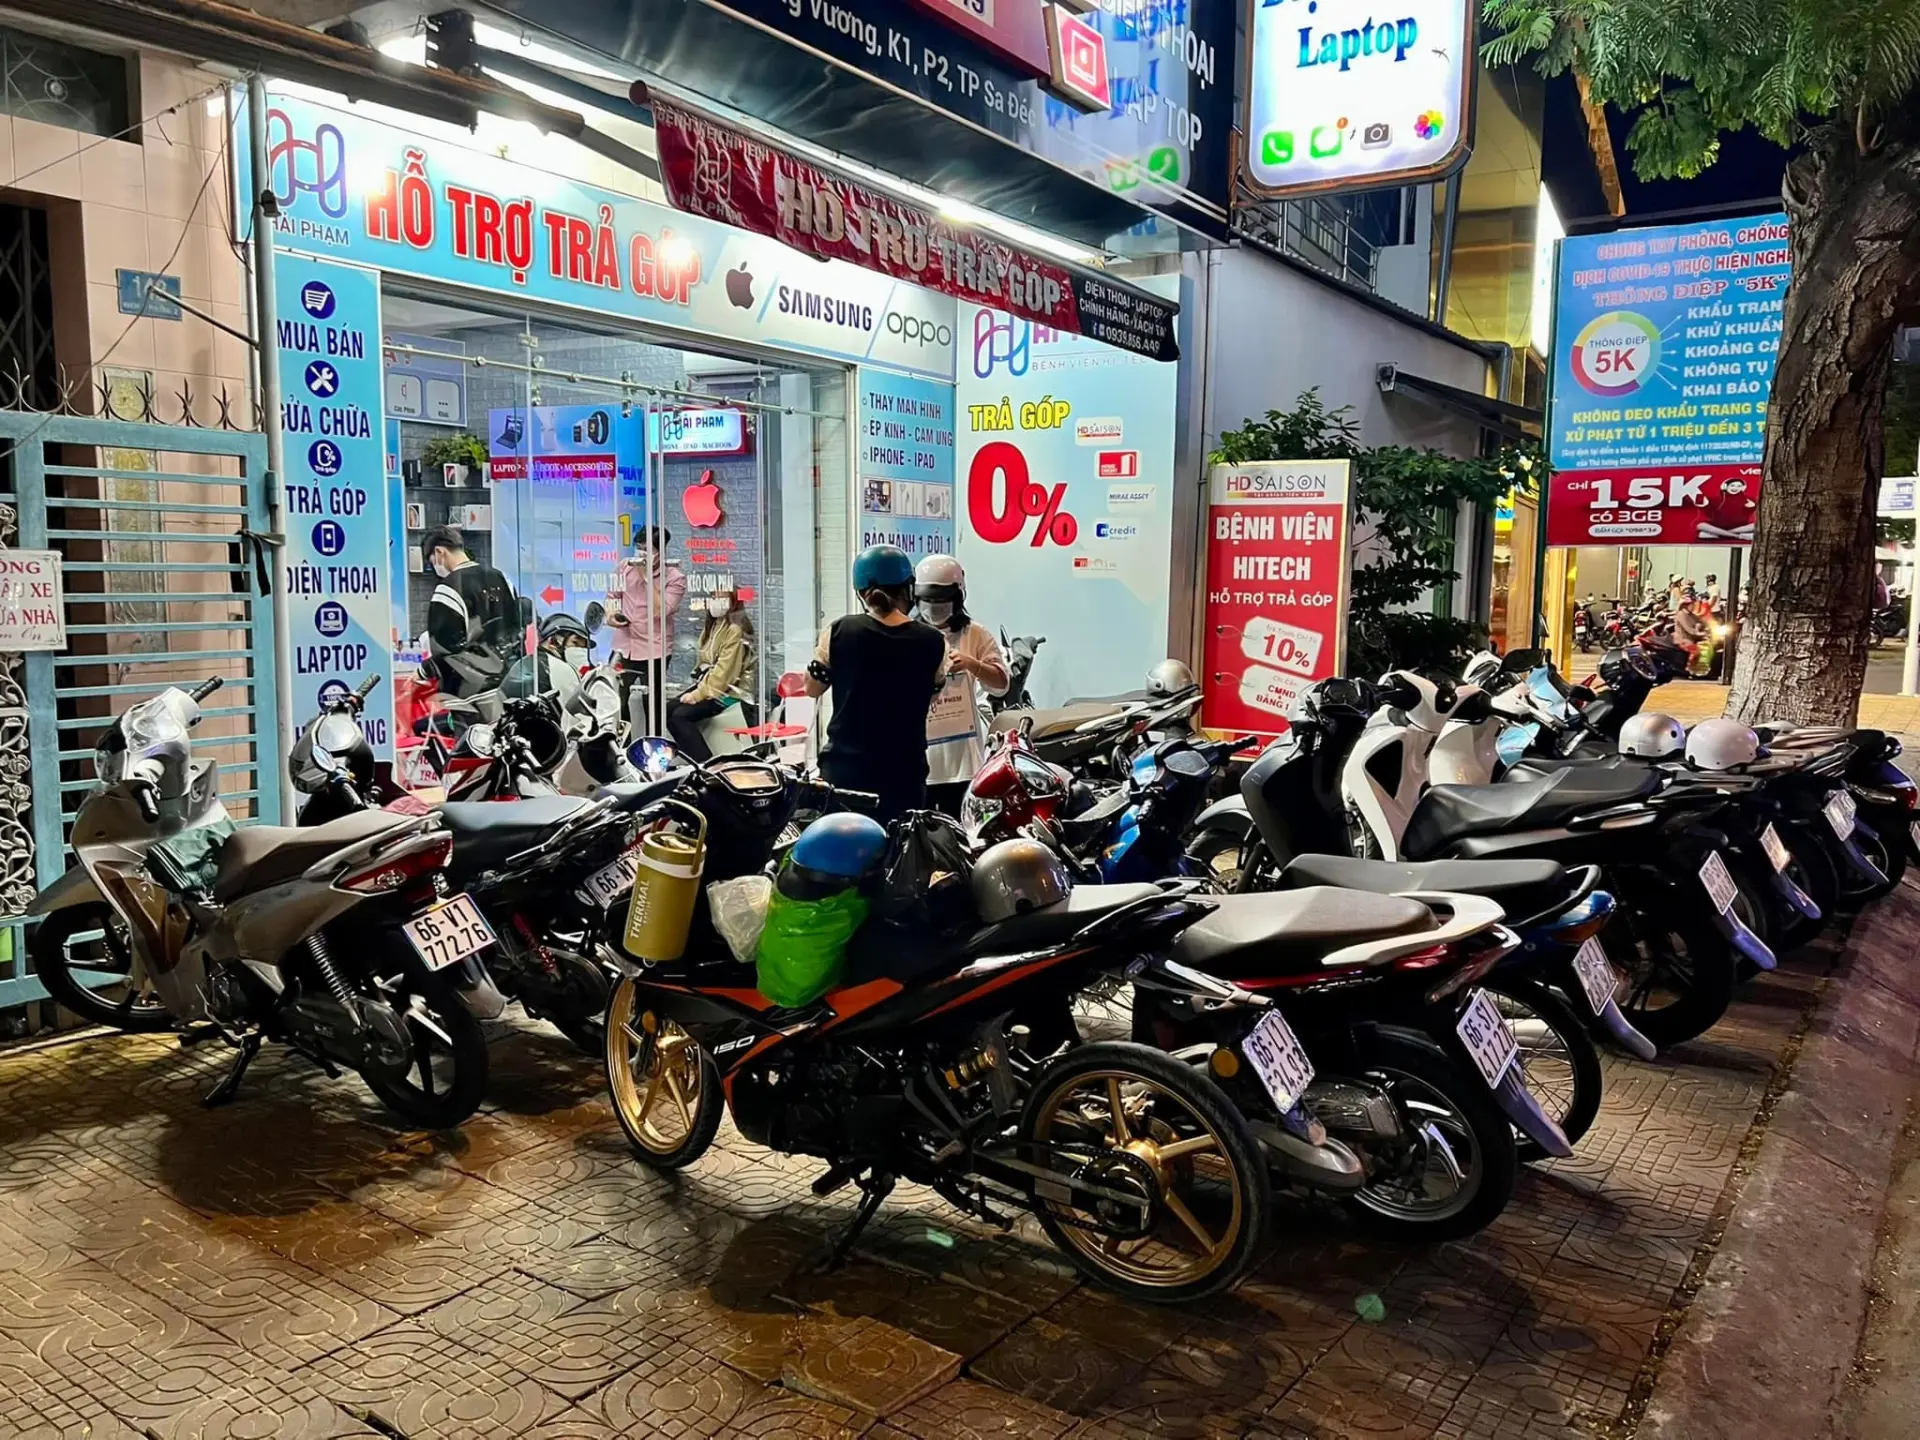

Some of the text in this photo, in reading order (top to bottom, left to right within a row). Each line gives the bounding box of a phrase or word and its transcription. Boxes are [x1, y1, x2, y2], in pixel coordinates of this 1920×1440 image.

[1297, 17, 1418, 72] Laptop
[808, 0, 883, 57] Vương,
[888, 28, 919, 75] K1,
[923, 48, 953, 92] P2,
[956, 64, 980, 98] TP
[983, 82, 1004, 113] Sa
[1007, 91, 1036, 127] Đéc
[1163, 97, 1203, 151] TOP
[300, 219, 349, 247] PHẠM
[366, 148, 701, 306] HỖ TRỢ TRẢ GÓP
[1650, 237, 1676, 254] TAY
[1679, 229, 1733, 249] PHÒNG,
[1736, 220, 1789, 244] CHỐNG
[1573, 252, 1751, 290] DỊCH COVID-19 THỰC HIỆN
[1008, 264, 1061, 316] GÓP
[1592, 286, 1667, 307] THÔNG
[1674, 279, 1728, 300] ĐIỆP
[778, 284, 953, 348] SAMSUNG oppo
[1687, 300, 1733, 320] KHẨU
[277, 319, 320, 353] MUA
[326, 322, 364, 359] BÁN
[1686, 322, 1720, 339] KHỬ
[1594, 348, 1636, 374] 5K
[1685, 341, 1750, 359] KHOẢNG
[1684, 361, 1768, 378] KHÔNG TỤ
[869, 392, 894, 411] THAY
[1683, 384, 1721, 397] KHAI
[1726, 378, 1760, 394] BÁO
[319, 403, 371, 438] CHỮA
[870, 414, 882, 436] ÉP
[968, 394, 1071, 431] TRẢ GÓP
[1572, 400, 1752, 424] KHÔNG ĐEO KHẨU TRANG
[1587, 428, 1623, 444] PHẠT
[1650, 427, 1657, 438] 1
[1662, 424, 1705, 441] TRIỆU
[1708, 419, 1739, 436] ĐẾN
[1743, 422, 1752, 434] 3
[869, 447, 935, 469] IPHONE IPAD
[285, 478, 366, 516] TRẢ GÓP
[968, 441, 1078, 547] 0%
[1589, 475, 1712, 509] 15K
[1215, 511, 1334, 546] BỆNH VIỆN
[1617, 510, 1662, 522] 3GB
[327, 566, 377, 600] THOẠI
[1233, 556, 1311, 580] HITECH
[30, 582, 53, 598] XE
[1210, 587, 1333, 607] HỖ TRỢ TRẢ GÓP
[22, 604, 57, 625] NHÀ
[297, 643, 368, 674] LAPTOP
[1263, 633, 1310, 668] 10%
[1267, 684, 1297, 699] CMND
[414, 903, 469, 942] 66-V1
[630, 879, 650, 939] THERMAL
[423, 922, 488, 967] 772.76
[1463, 1000, 1495, 1049] 66-S1
[713, 1035, 756, 1055] 150
[1251, 1019, 1288, 1069] 66-L1
